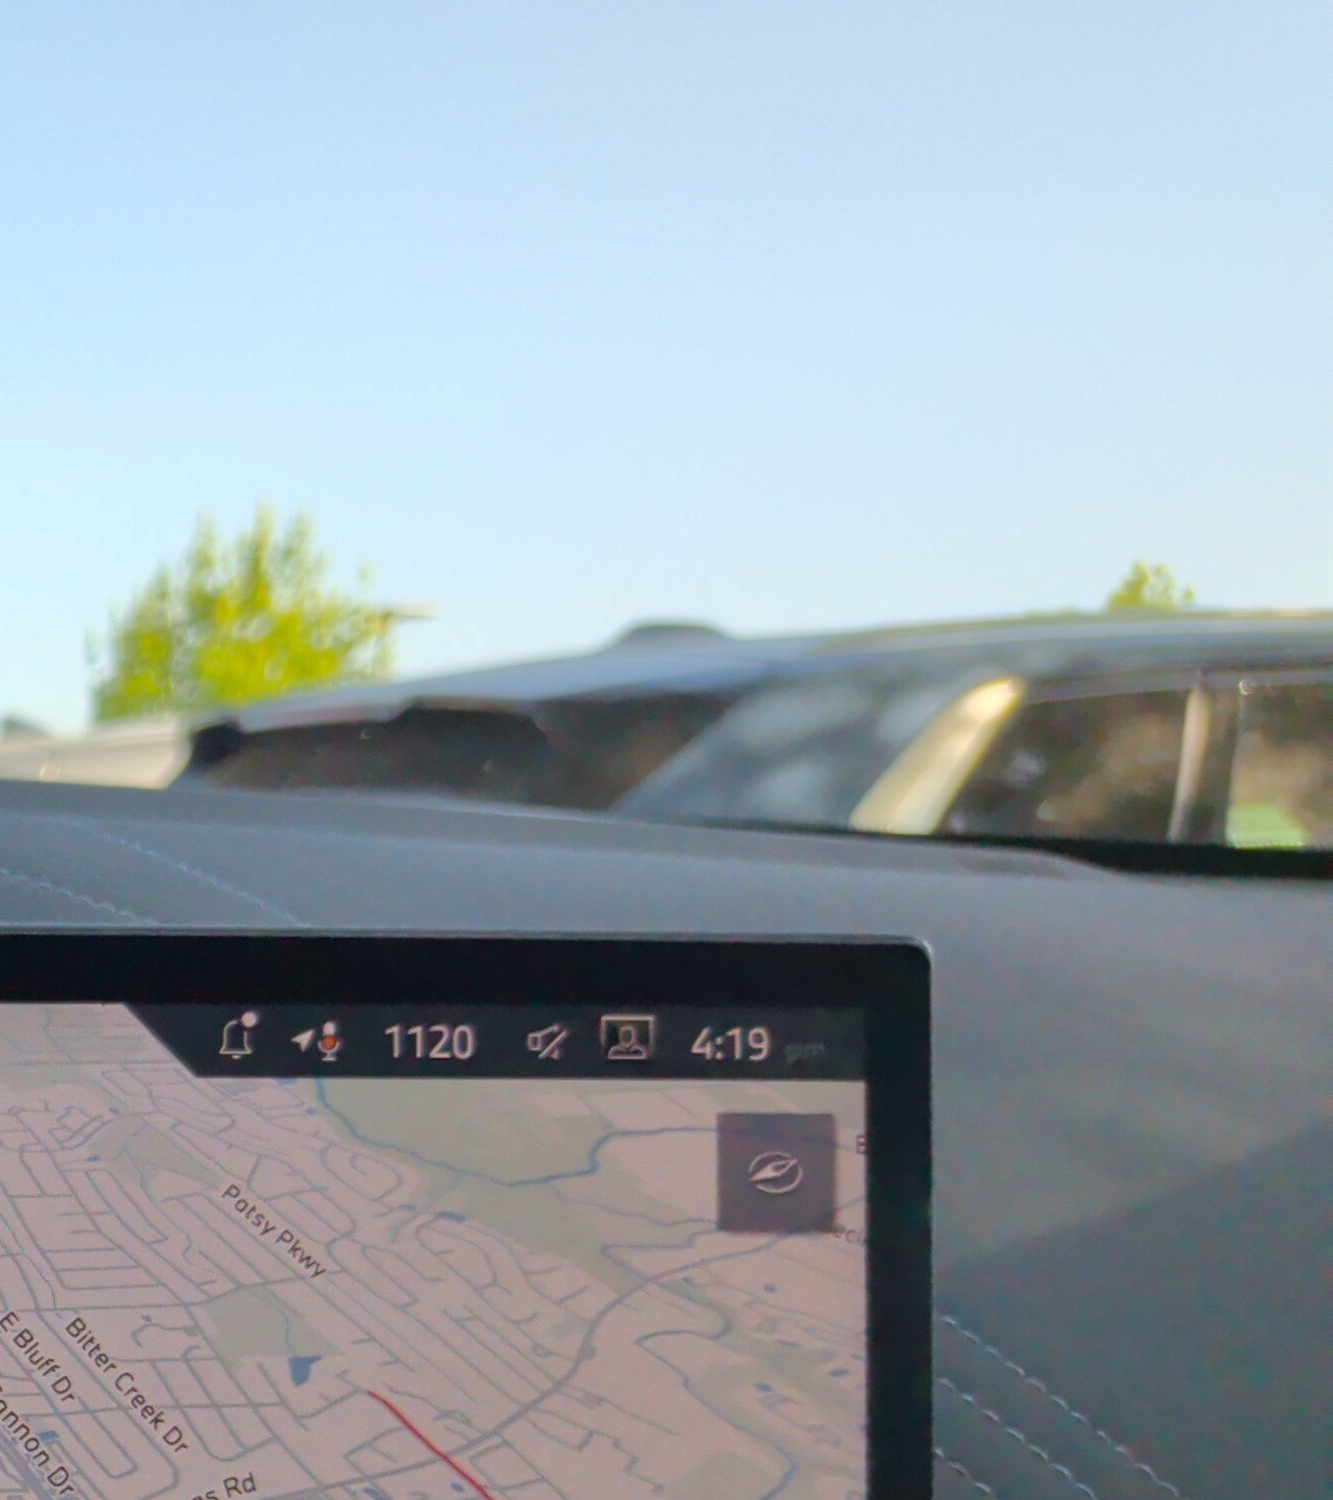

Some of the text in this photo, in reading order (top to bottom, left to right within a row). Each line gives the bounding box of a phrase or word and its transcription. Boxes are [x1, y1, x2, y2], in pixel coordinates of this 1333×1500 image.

[385, 1022, 477, 1060] 1120
[690, 1025, 773, 1061] 4:19
[221, 1184, 327, 1279] Patsy Pkwy
[12, 1328, 61, 1377] Bluff
[51, 1375, 76, 1402] Dr
[65, 1316, 189, 1453] Bitter Creek Dr
[46, 1466, 75, 1495] Dr
[222, 1471, 258, 1499] Rd
